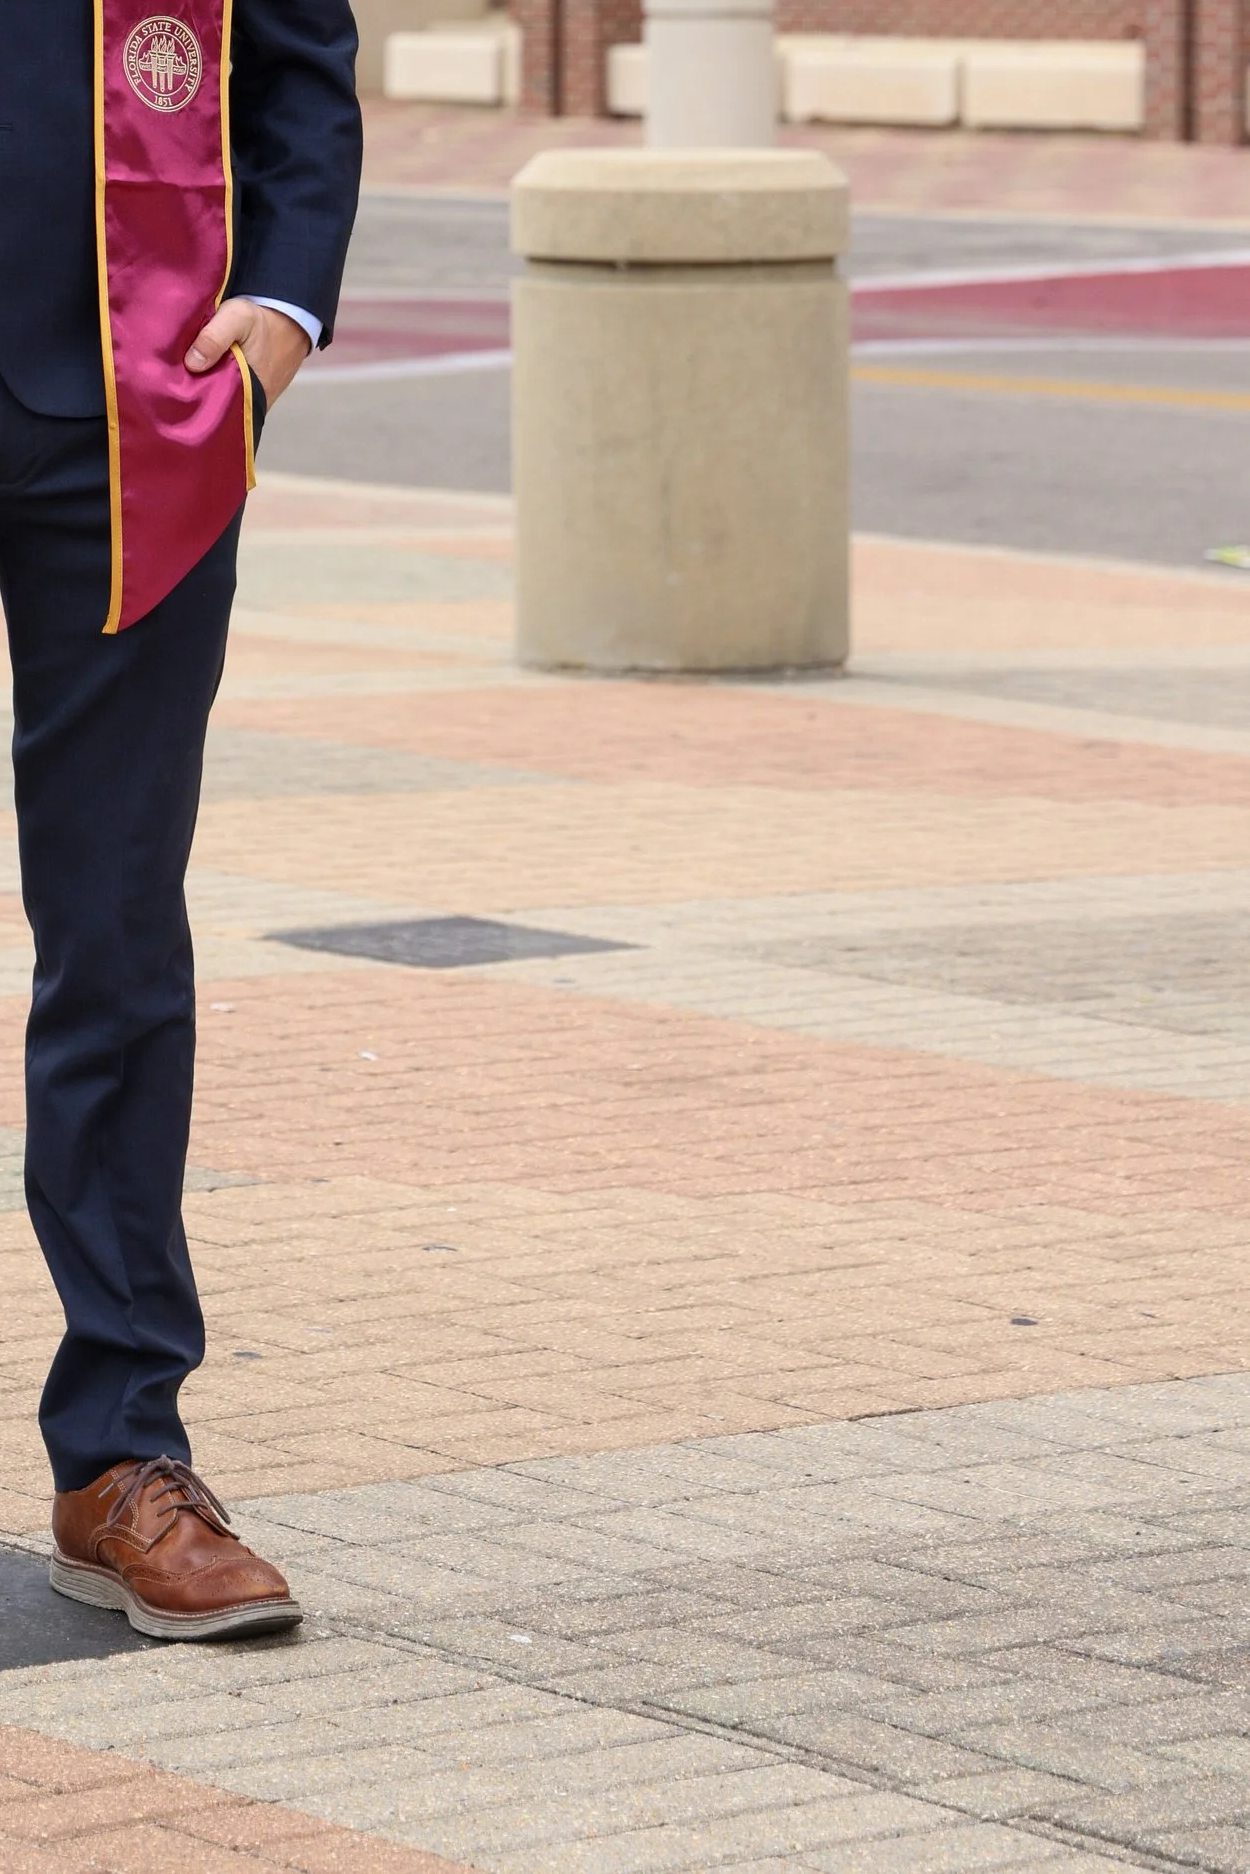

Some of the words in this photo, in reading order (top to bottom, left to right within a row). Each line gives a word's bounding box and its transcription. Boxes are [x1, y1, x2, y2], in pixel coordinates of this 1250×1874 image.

[128, 35, 142, 86] FLORIDA
[142, 22, 172, 36] STATE
[174, 27, 198, 92] UNIVERSITY
[154, 96, 172, 106] 1851
